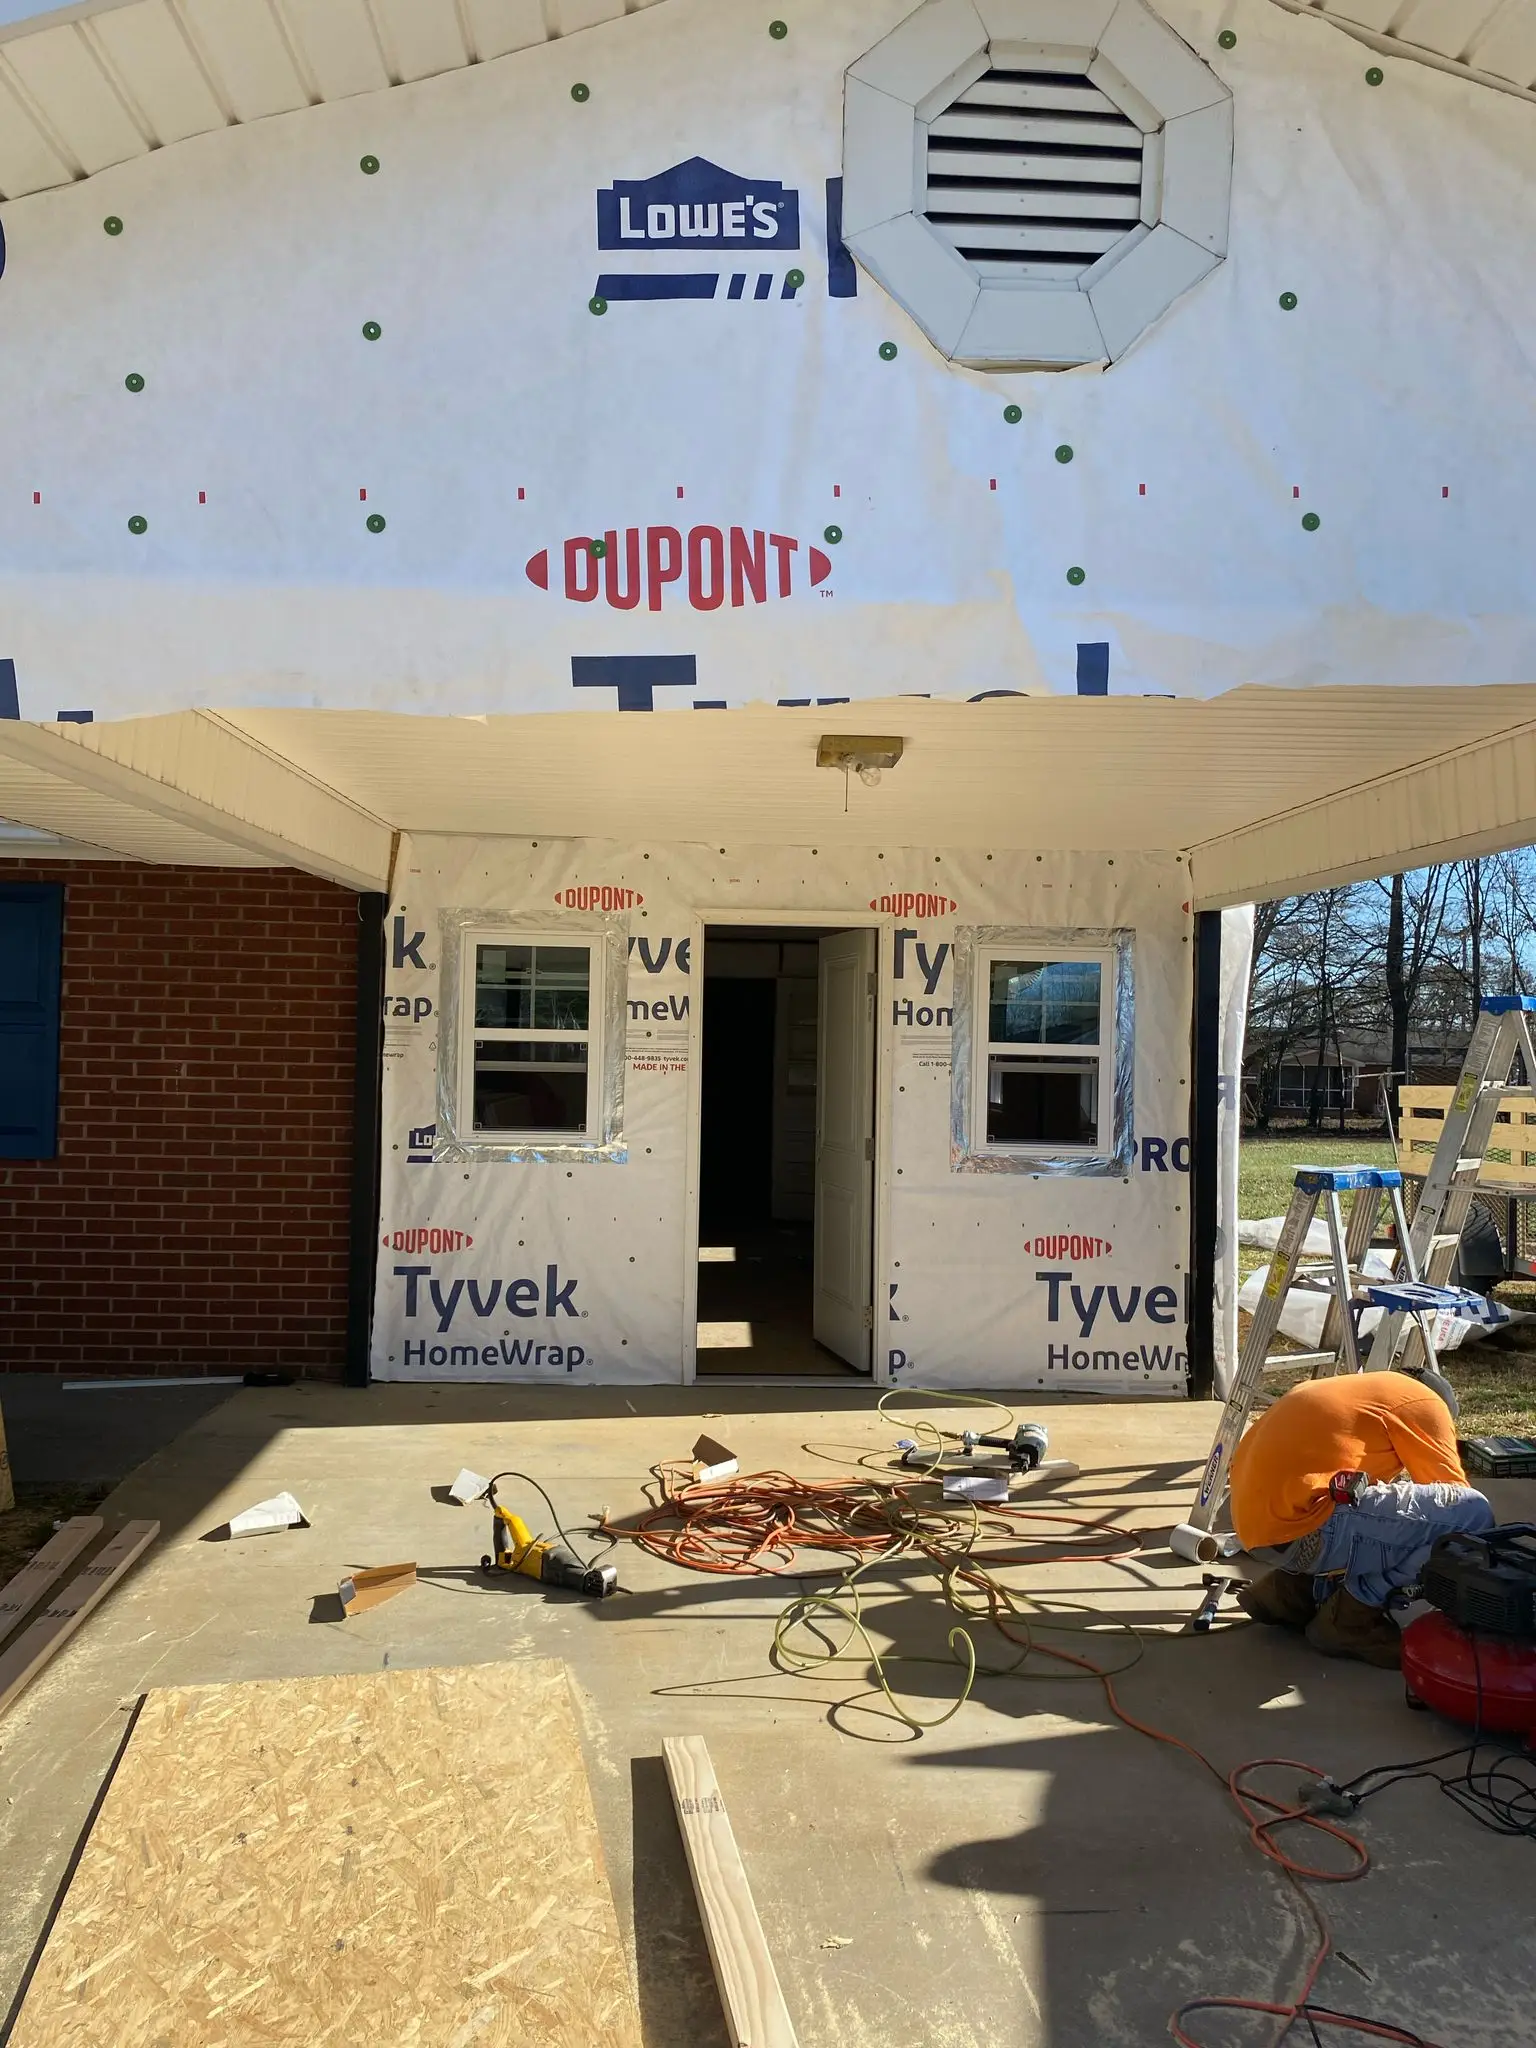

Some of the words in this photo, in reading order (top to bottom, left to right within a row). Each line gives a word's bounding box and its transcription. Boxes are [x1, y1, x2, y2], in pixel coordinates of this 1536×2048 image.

[619, 195, 779, 239] LOWE'S
[563, 525, 798, 612] DUPONT
[565, 886, 635, 912] DUPONT
[880, 892, 948, 918] DUPONT
[893, 929, 955, 995] Ty
[633, 1063, 657, 1071] MADE
[393, 1228, 464, 1254] DUPONT
[1034, 1235, 1103, 1260] DUPONT
[393, 1264, 580, 1333] Tyvek
[1035, 1272, 1190, 1337] Tyve
[403, 1339, 585, 1373] HomeWrap
[1203, 1455, 1219, 1494] WERNER
